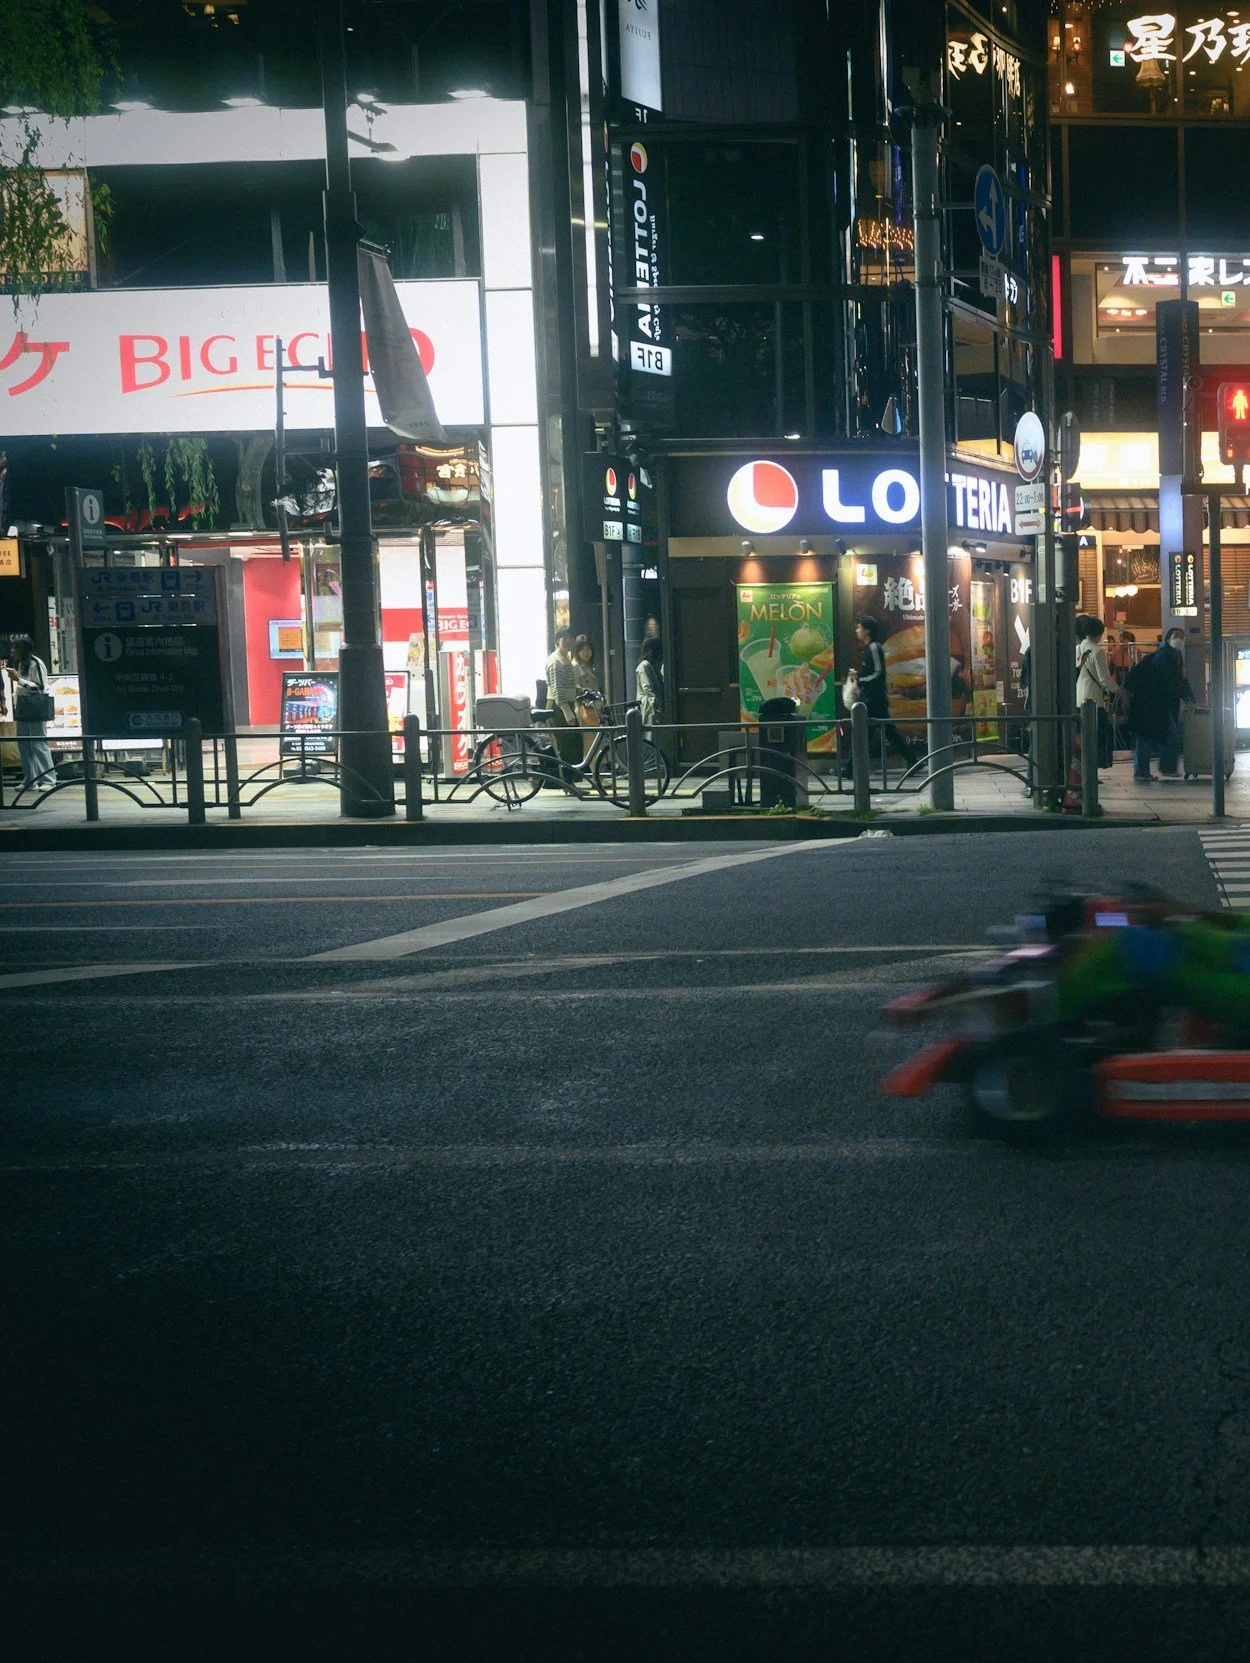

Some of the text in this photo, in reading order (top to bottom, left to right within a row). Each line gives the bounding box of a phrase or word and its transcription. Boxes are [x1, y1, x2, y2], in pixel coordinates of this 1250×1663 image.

[119, 335, 238, 394] BIG
[1160, 338, 1168, 383] CRYSTAL
[1182, 336, 1190, 379] CRYSTA
[1010, 578, 1033, 604] B1F
[1187, 564, 1195, 606] LOTTERIA
